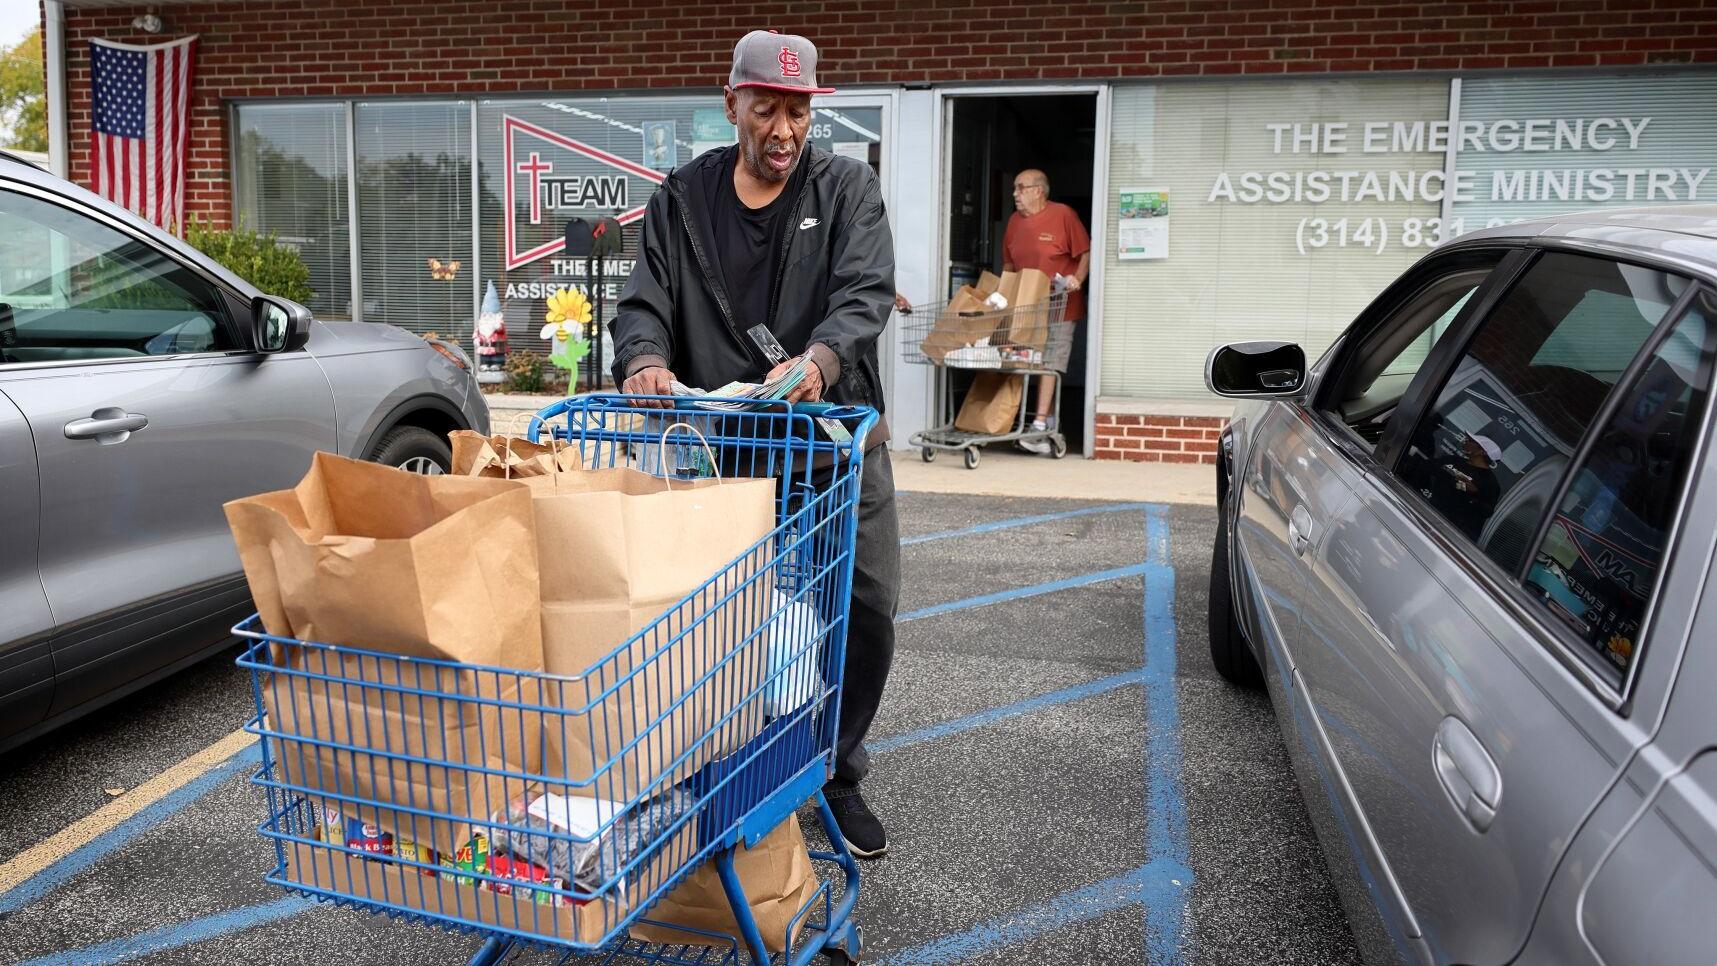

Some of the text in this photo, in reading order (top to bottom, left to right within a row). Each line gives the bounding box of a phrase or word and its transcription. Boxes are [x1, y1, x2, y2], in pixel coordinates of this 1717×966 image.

[1266, 117, 1651, 153] THE EMERGENCY
[539, 176, 628, 209] TEAM
[1208, 167, 1711, 202] ASSISTANCE MINISTRY
[1296, 217, 1388, 255] (314)
[551, 260, 587, 276] THE
